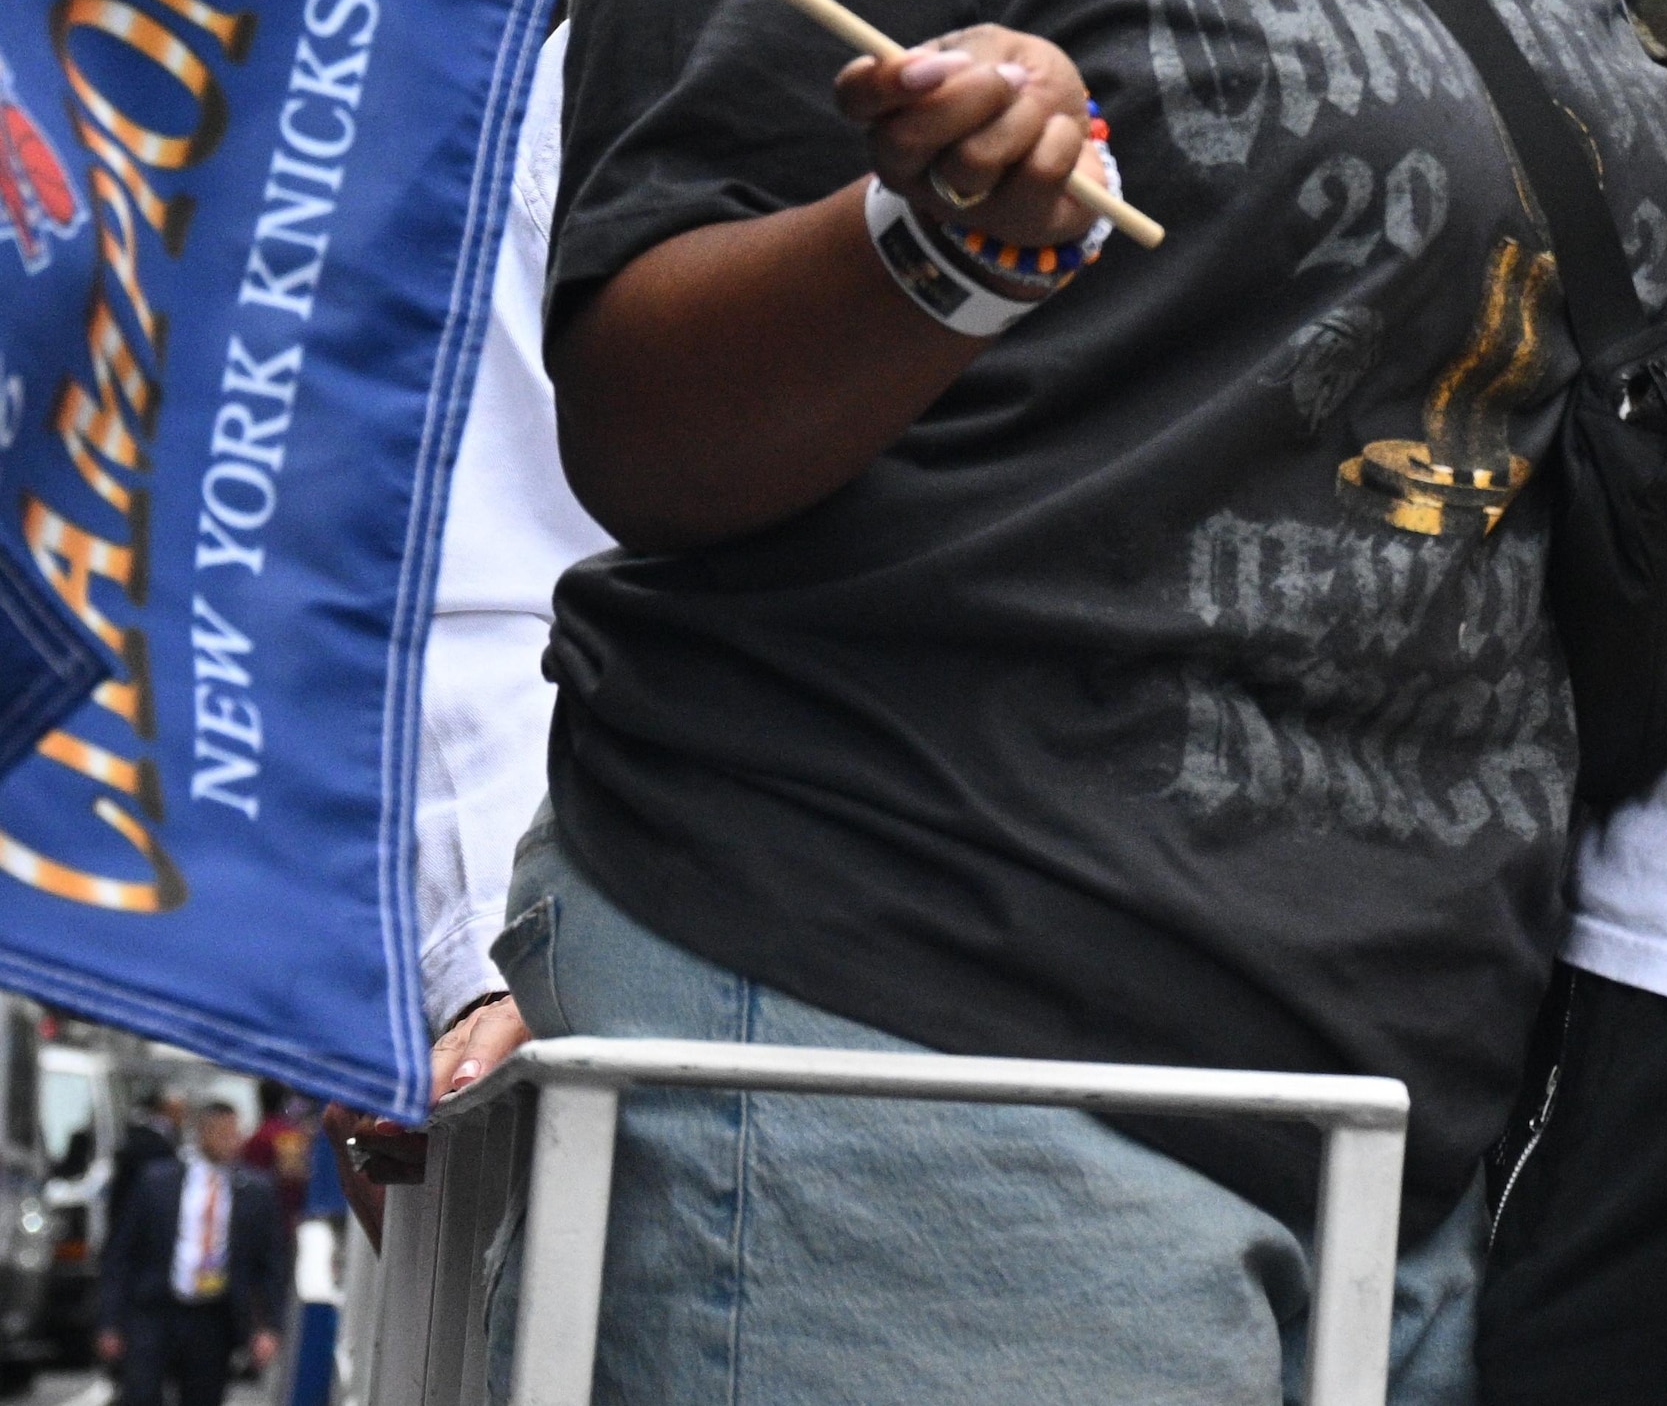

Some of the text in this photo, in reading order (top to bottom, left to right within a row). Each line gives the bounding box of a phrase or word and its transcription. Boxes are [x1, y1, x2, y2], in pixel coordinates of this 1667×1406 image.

[1294, 147, 1450, 278] 20
[194, 335, 305, 576] YORK
[189, 594, 263, 821] NEW
